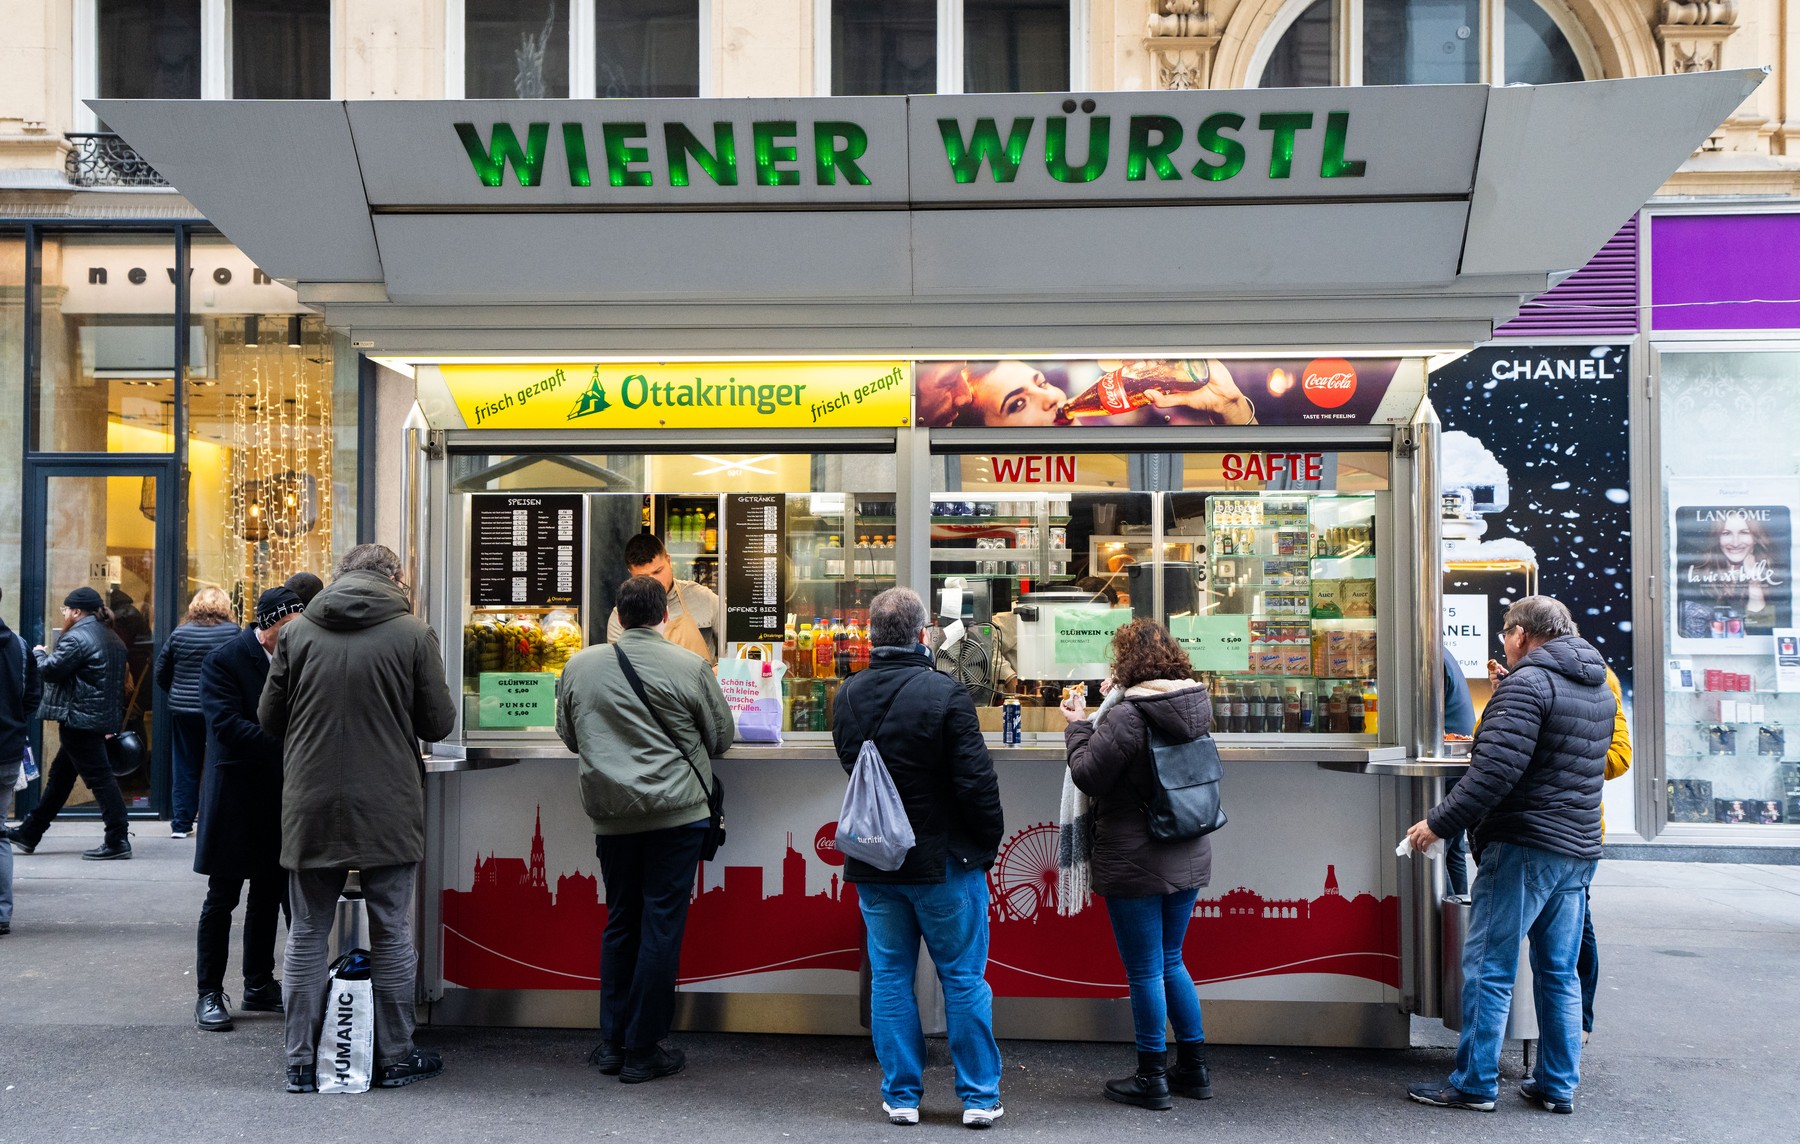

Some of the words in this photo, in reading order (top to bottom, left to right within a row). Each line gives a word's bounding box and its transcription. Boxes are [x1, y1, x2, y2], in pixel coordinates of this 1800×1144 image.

[453, 121, 872, 187] WIENER
[936, 98, 1367, 183] WÜRSTL
[1304, 372, 1355, 390] Coca-Cola
[1491, 359, 1615, 380] CHANEL
[475, 393, 514, 425] frisch
[517, 368, 567, 406] gezapft
[621, 374, 807, 415] Ottakringer
[811, 391, 850, 423] frisch
[854, 366, 904, 404] gezapft
[991, 455, 1077, 483] WEIN
[1060, 628, 1101, 636] GLÜHWEIN
[1443, 625, 1481, 637] NEL
[735, 687, 760, 696] kleine
[745, 680, 758, 688] ist,
[333, 992, 354, 1087] HUMANIC
